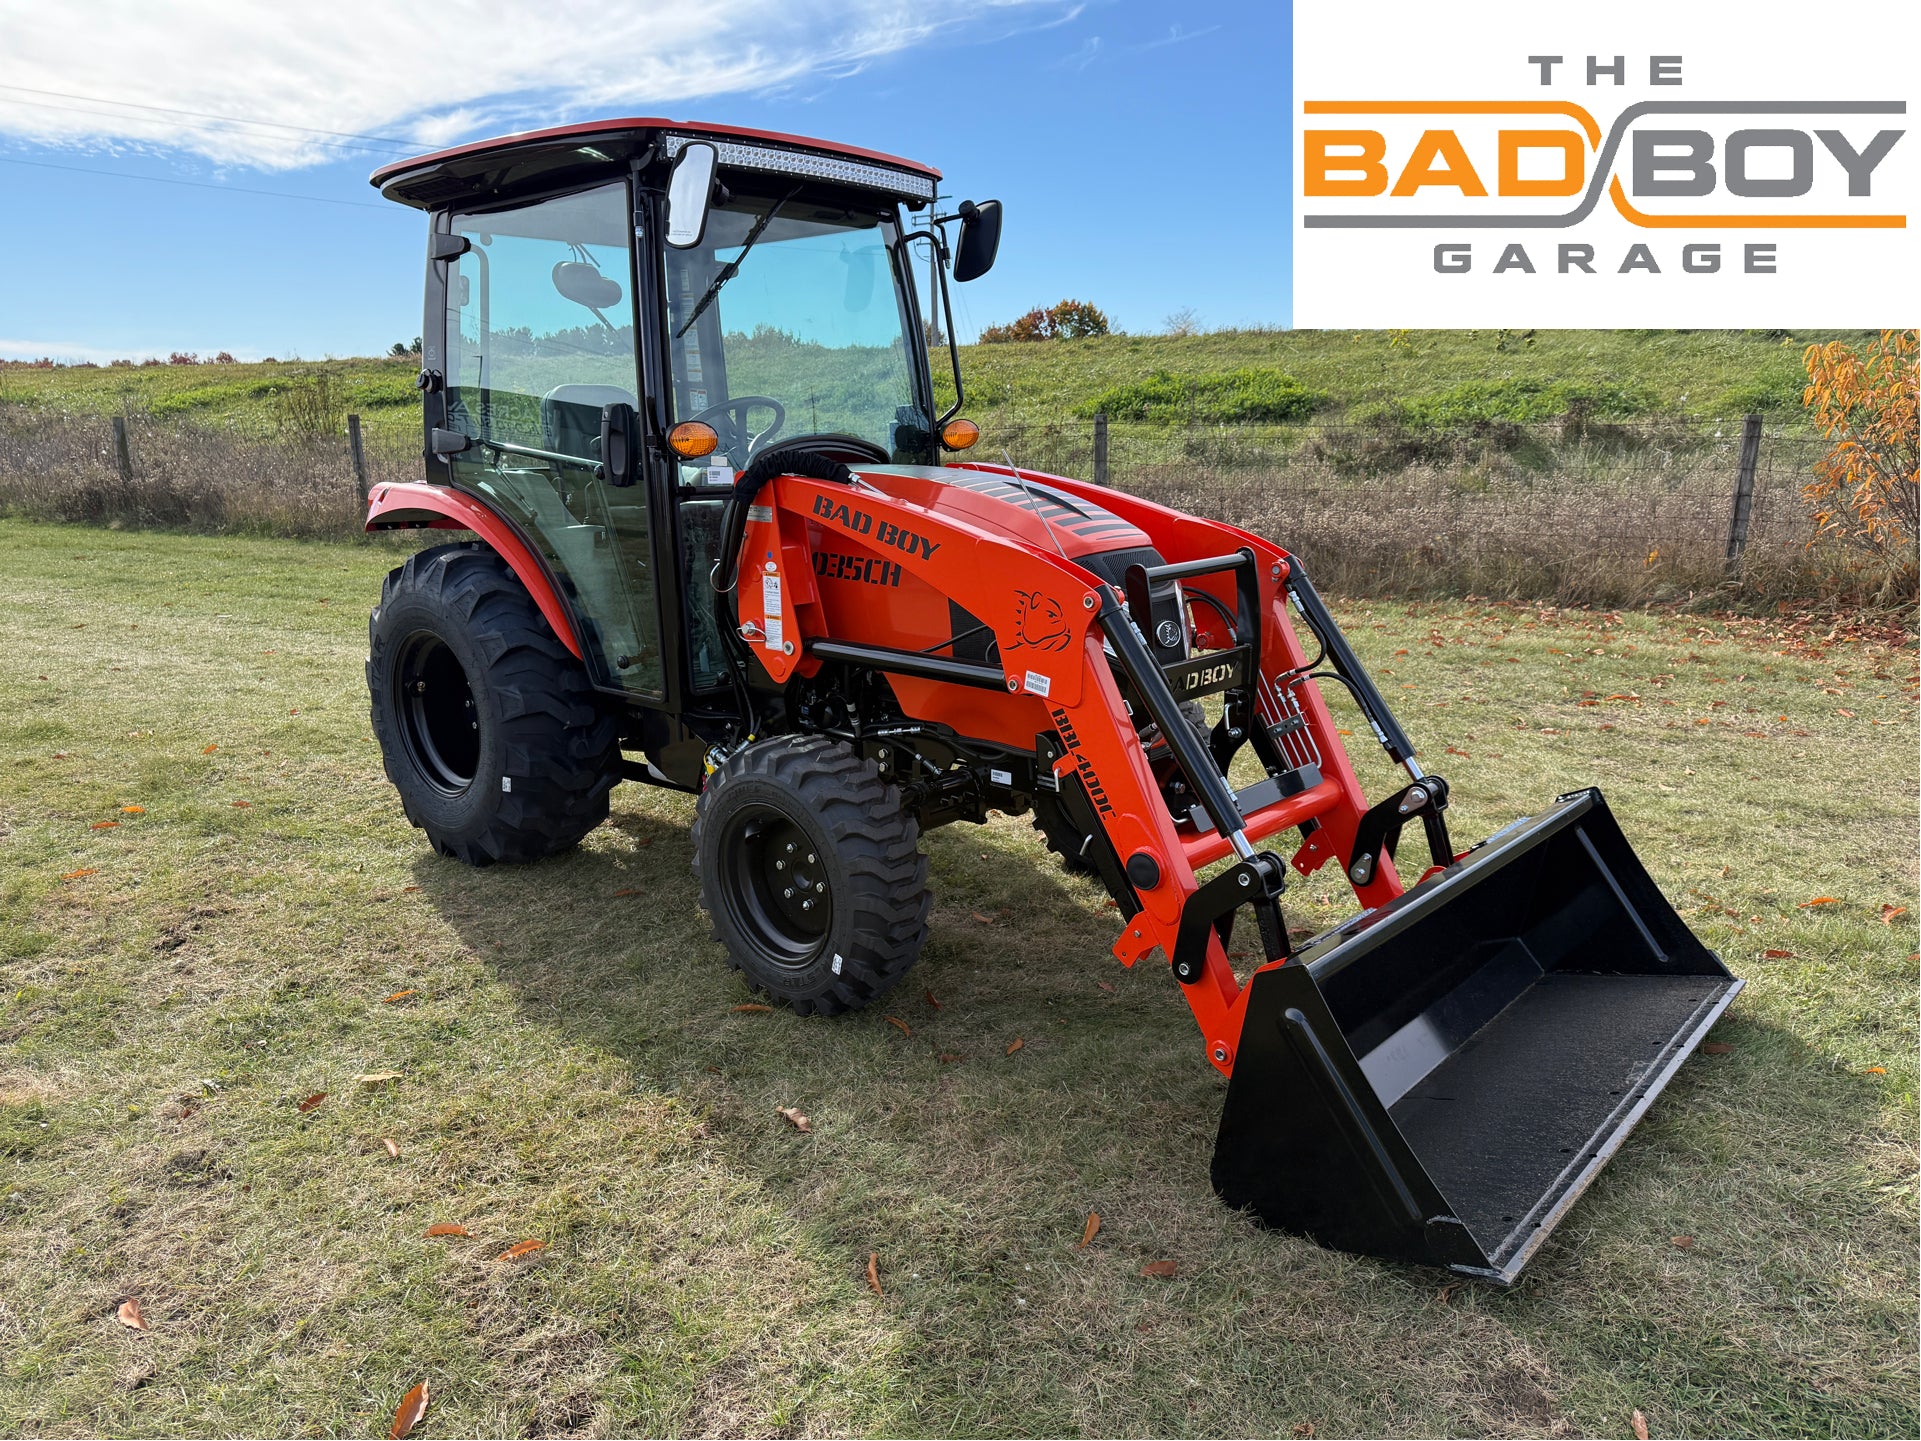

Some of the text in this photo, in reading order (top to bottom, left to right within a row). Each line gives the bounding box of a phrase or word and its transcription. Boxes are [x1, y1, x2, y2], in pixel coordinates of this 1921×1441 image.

[812, 494, 941, 561] BAD BOY
[1200, 660, 1239, 687] BOY
